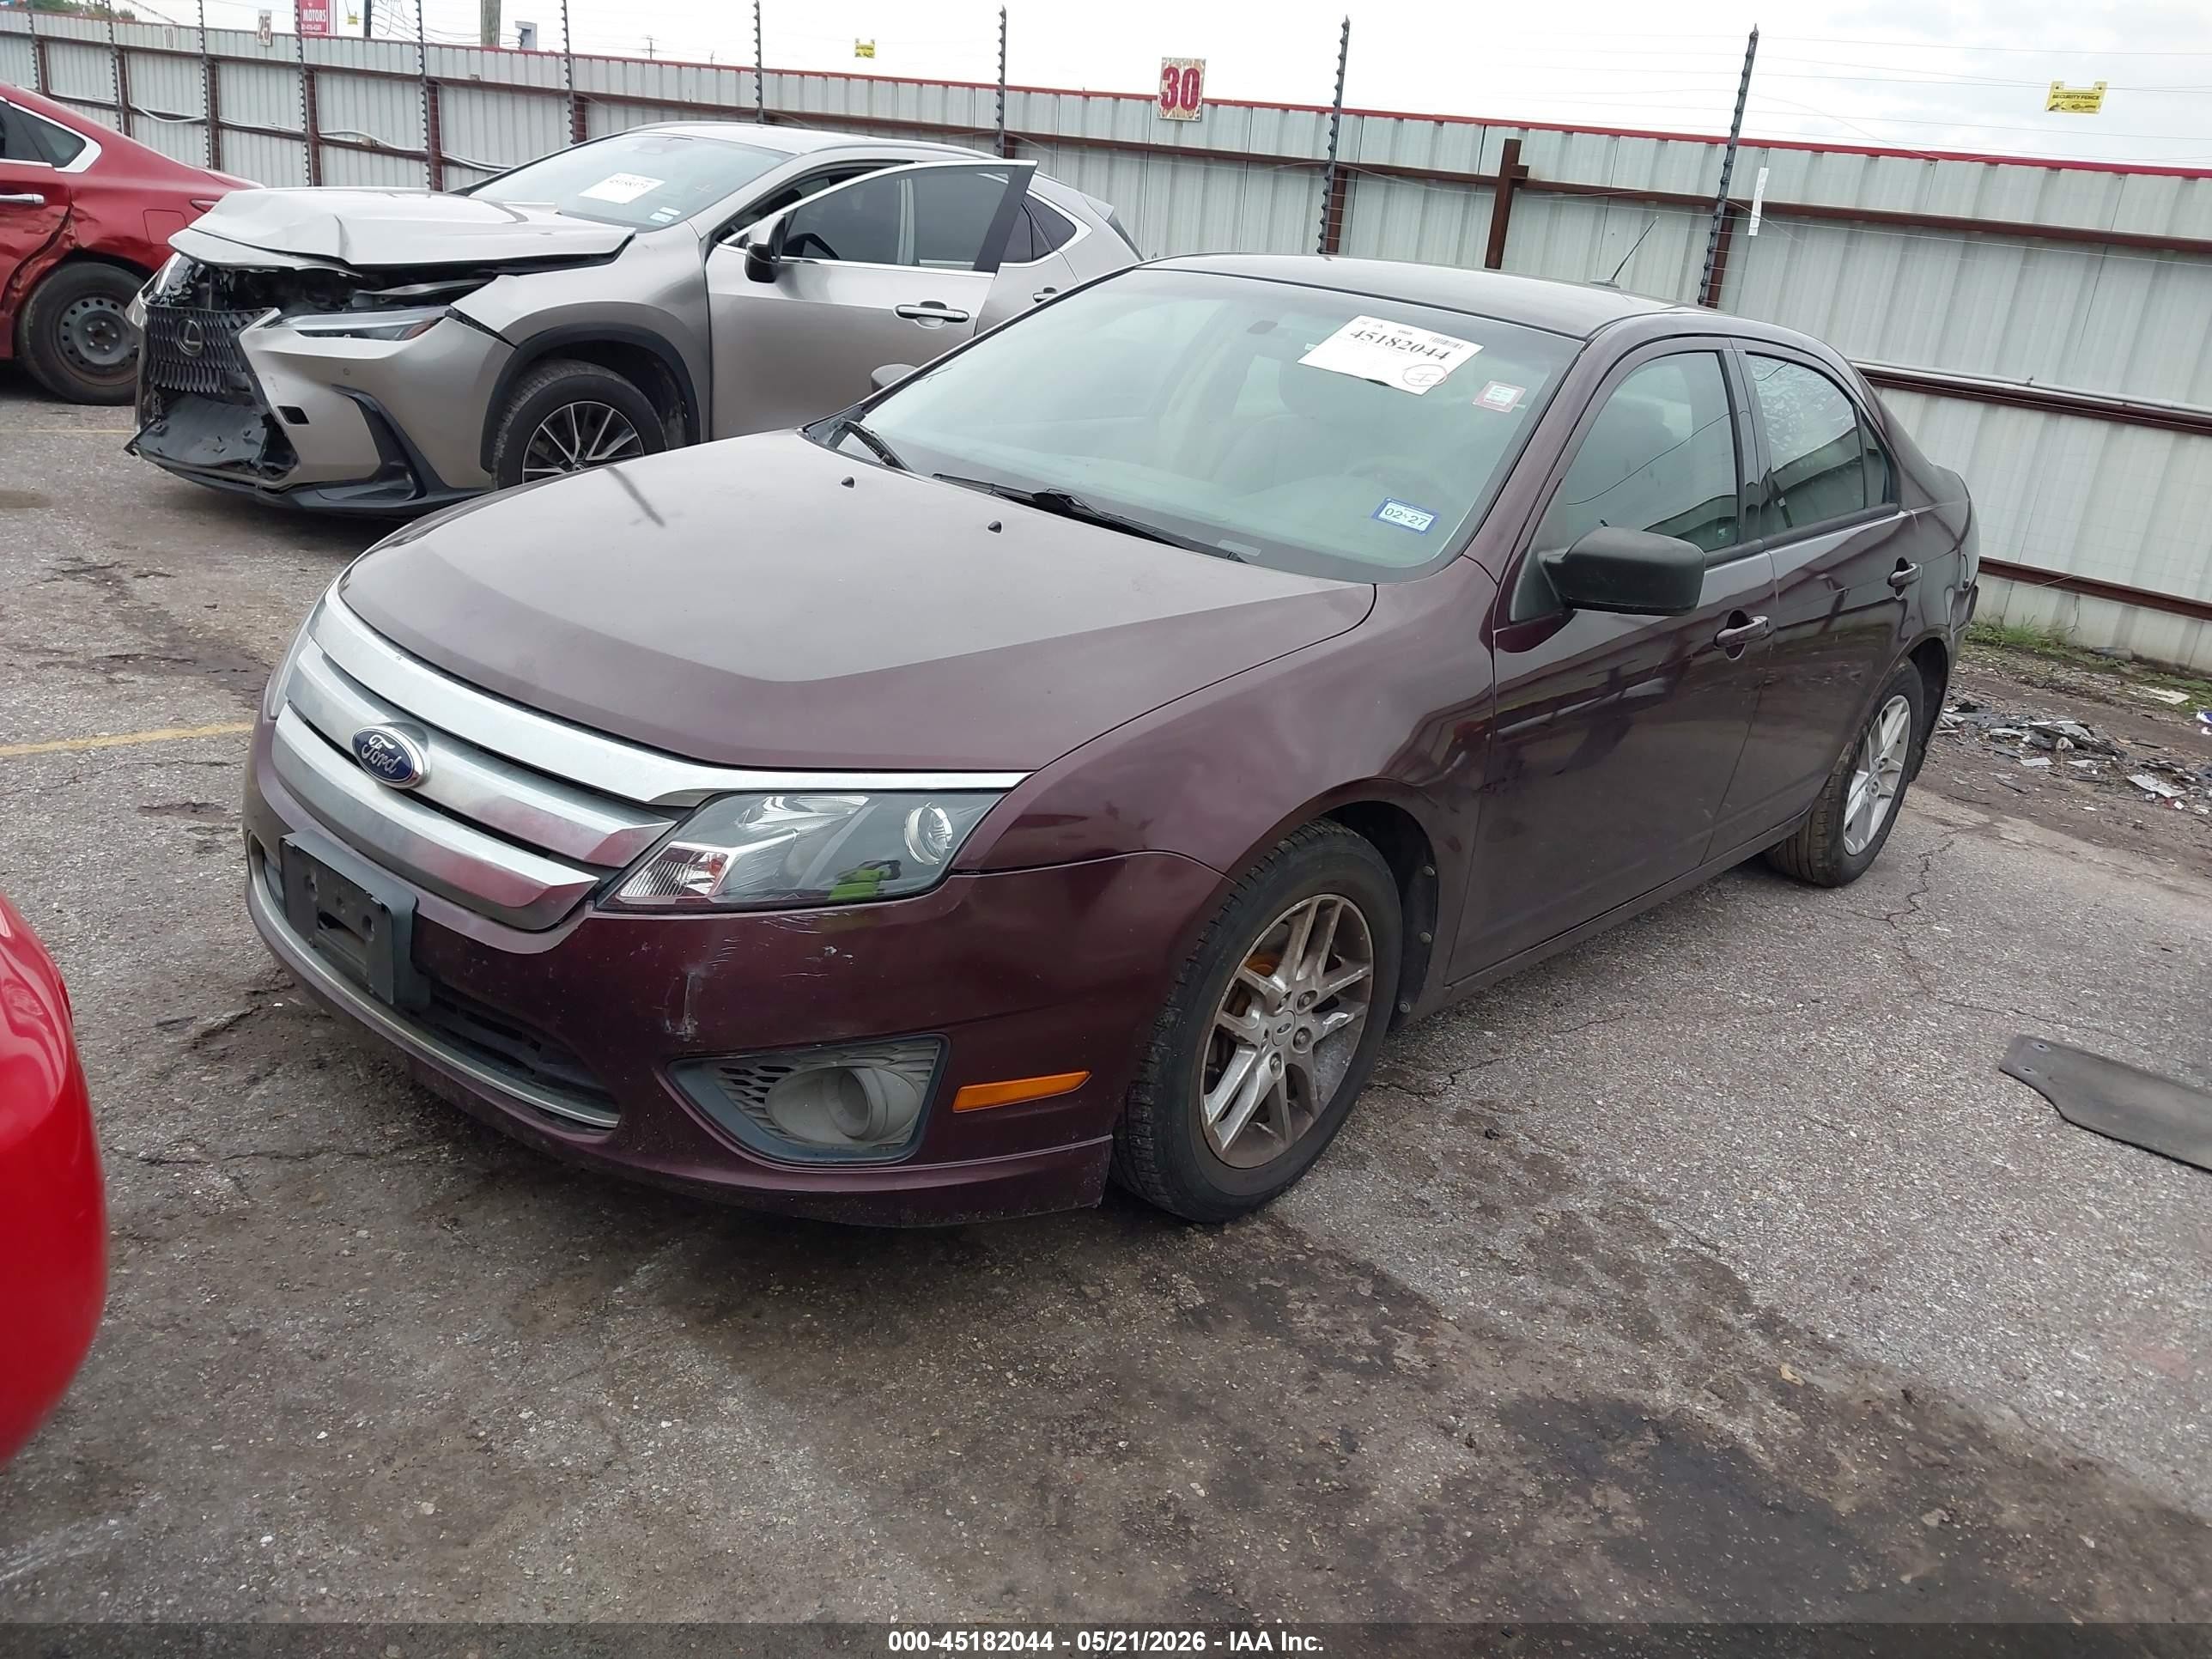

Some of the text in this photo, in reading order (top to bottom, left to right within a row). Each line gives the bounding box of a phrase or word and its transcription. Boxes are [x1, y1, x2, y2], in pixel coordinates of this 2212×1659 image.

[258, 15, 271, 40] 25
[303, 9, 326, 22] MOTORS
[165, 27, 174, 49] 10
[1160, 66, 1200, 111] 30
[1350, 329, 1451, 361] 45182044
[361, 734, 403, 775] Ford
